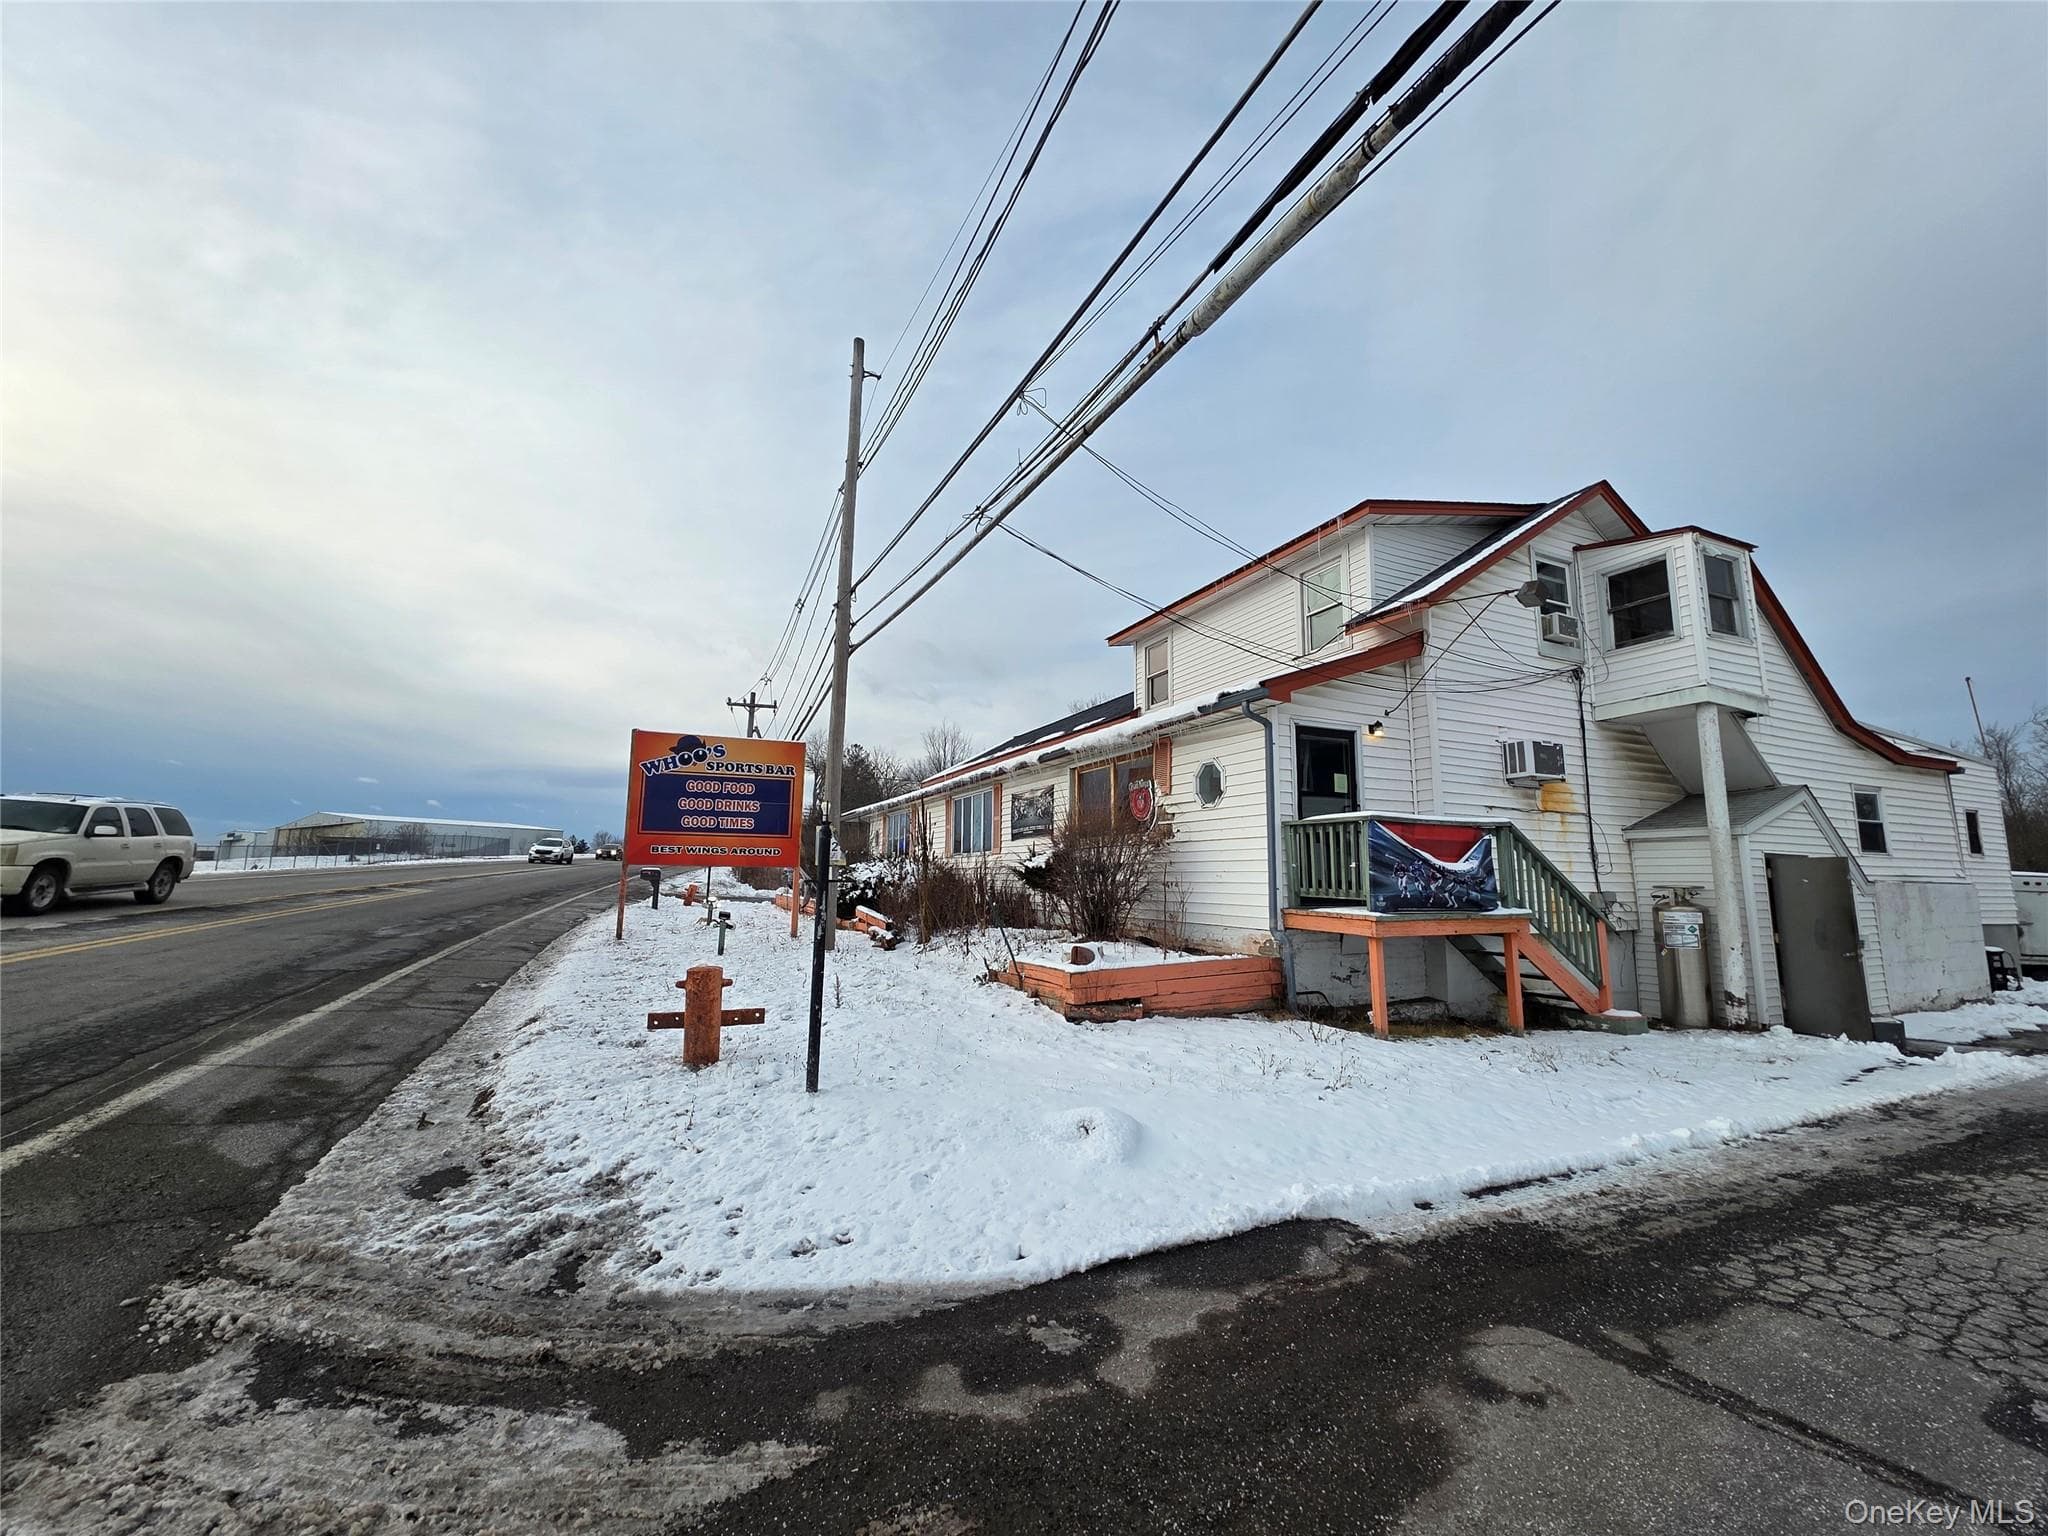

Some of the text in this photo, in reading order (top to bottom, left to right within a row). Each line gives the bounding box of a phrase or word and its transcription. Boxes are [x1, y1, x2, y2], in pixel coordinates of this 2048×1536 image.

[640, 744, 726, 776] WHOO'S
[705, 761, 795, 777] SPORTS BAR
[686, 780, 755, 794] GOOD FOOD
[678, 798, 760, 812] GOOD DRINKS
[681, 816, 754, 829] GOOD TIMES
[650, 845, 782, 856] BEST WINGS AROUND
